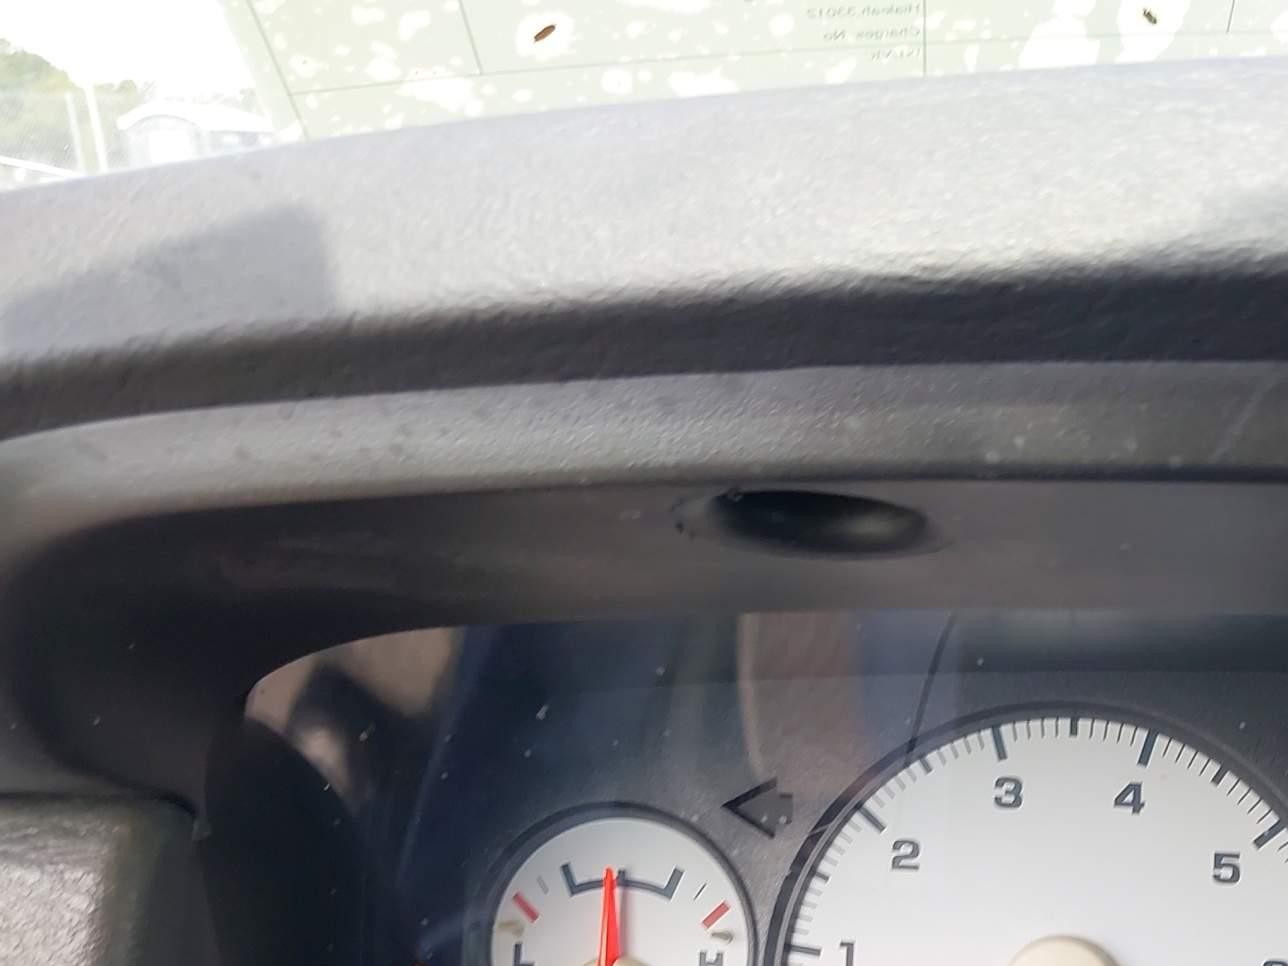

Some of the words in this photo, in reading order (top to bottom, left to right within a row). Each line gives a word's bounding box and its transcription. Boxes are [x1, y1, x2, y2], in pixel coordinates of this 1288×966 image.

[994, 776, 1023, 809] 3
[1113, 782, 1145, 814] 4
[891, 839, 920, 871] 2
[1212, 852, 1241, 884] 5
